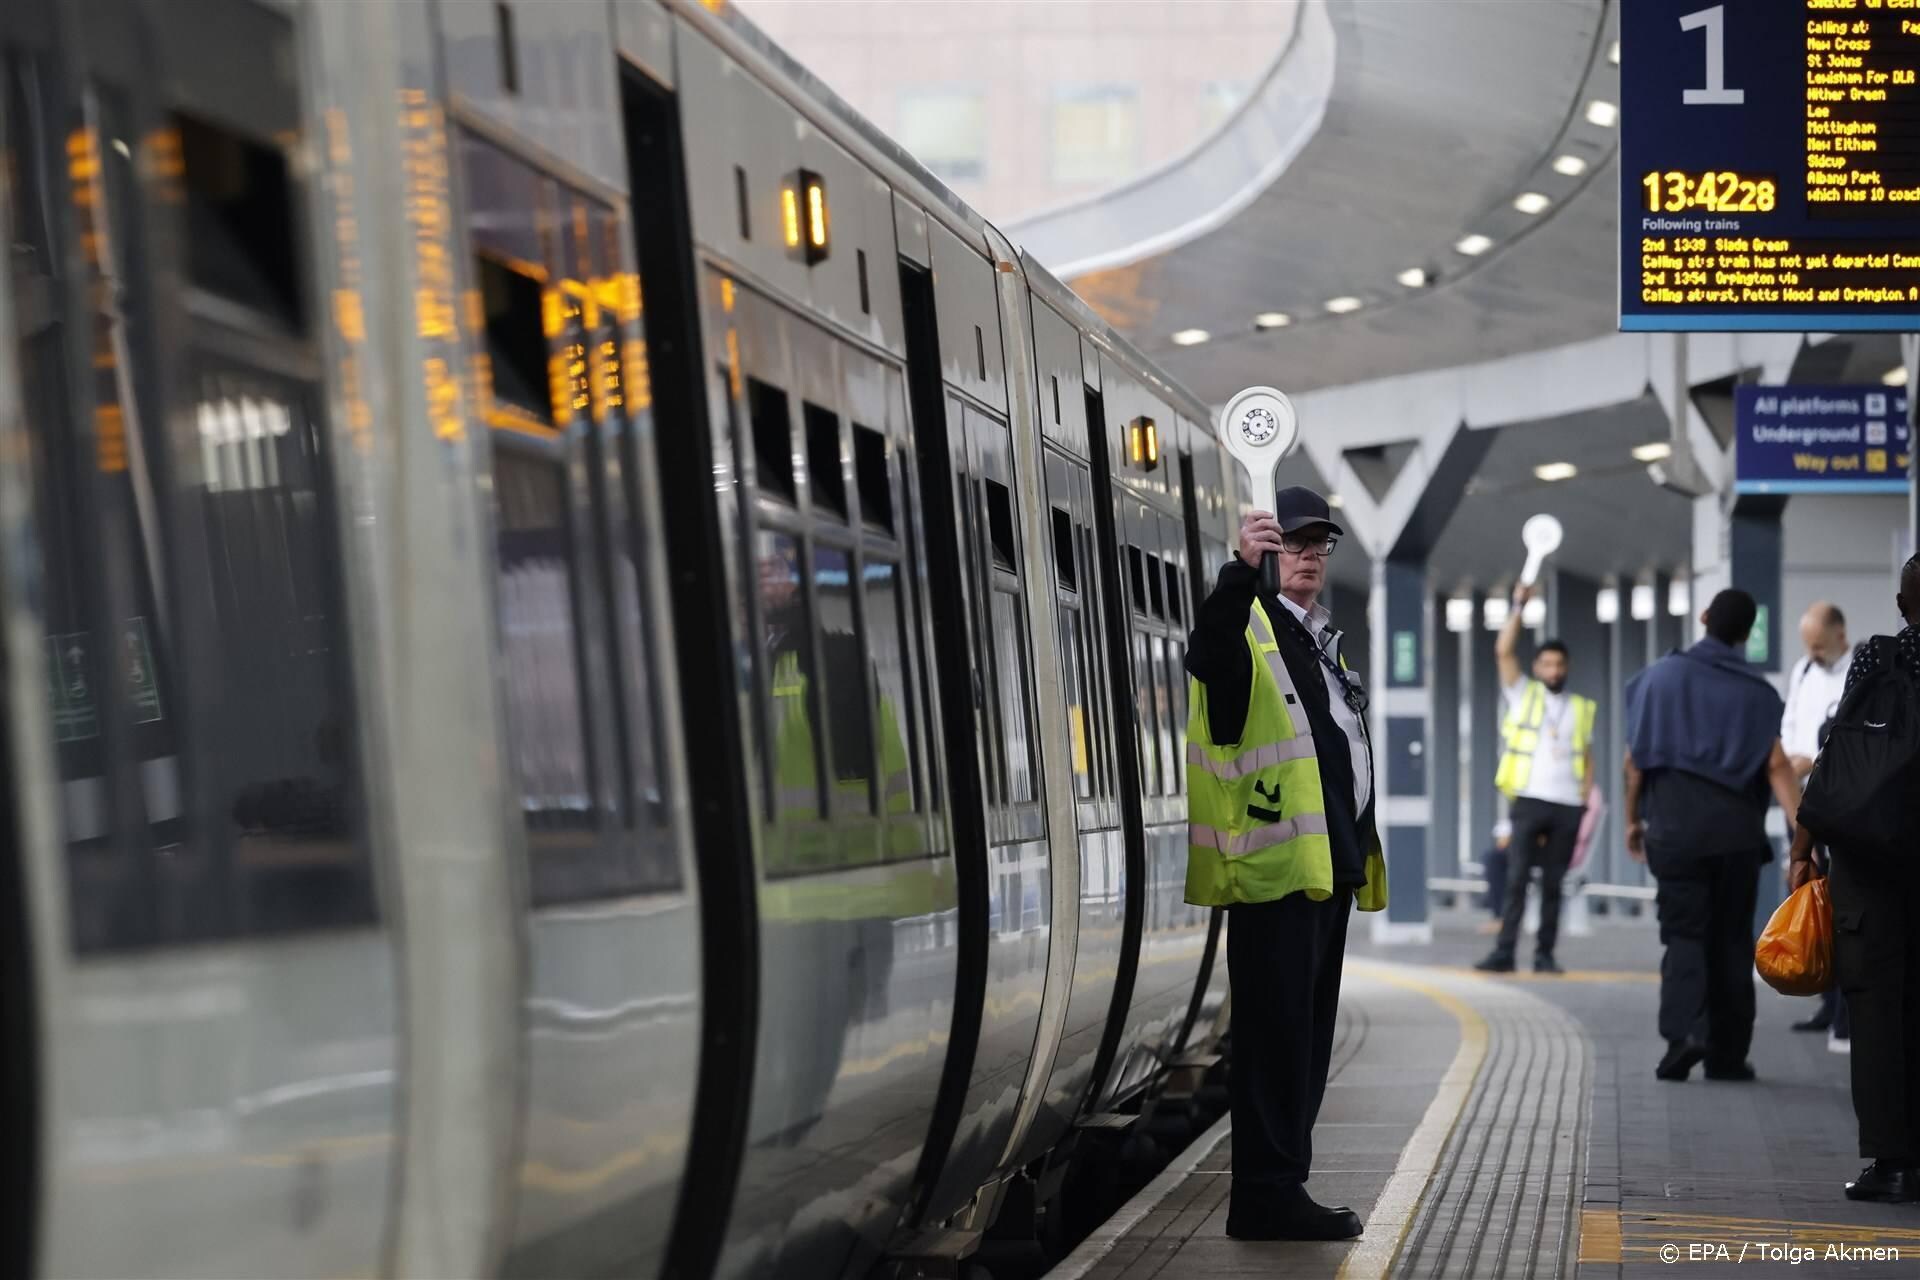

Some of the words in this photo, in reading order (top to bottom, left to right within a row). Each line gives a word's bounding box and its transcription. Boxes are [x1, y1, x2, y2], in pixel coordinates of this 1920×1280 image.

[1807, 20, 1848, 35] Calling
[1851, 20, 1870, 34] at:
[1807, 37, 1831, 51] New
[1834, 37, 1871, 51] Cross
[1679, 4, 1745, 105] 1
[1807, 53, 1823, 68] St
[1826, 53, 1863, 68] Johns
[1807, 70, 1863, 84] Lewisham
[1866, 70, 1889, 84] For
[1892, 70, 1915, 84] DLR
[1807, 87, 1846, 101] Hither
[1850, 87, 1886, 101] Green
[1807, 103, 1830, 118] Lee
[1807, 120, 1877, 136] Mottingham
[1807, 137, 1831, 151] New
[1834, 137, 1877, 151] Eltham
[1807, 153, 1847, 169] Sidcup
[1807, 170, 1848, 186] Albany
[1851, 170, 1881, 184] Park
[1807, 187, 1841, 201] which
[1844, 187, 1867, 201] has
[1870, 187, 1885, 201] 10
[1642, 218, 1702, 233] Following
[1705, 218, 1740, 231] trains
[1642, 238, 1665, 252] 2nd
[1673, 238, 1707, 252] 13:39
[1715, 238, 1749, 252] Slade
[1752, 238, 1789, 252] Green
[1642, 254, 1683, 270] Calling
[1719, 254, 1750, 268] train
[1754, 254, 1777, 268] has
[1780, 254, 1802, 268] not
[1806, 254, 1829, 270] yet
[1832, 254, 1889, 269] departed
[1892, 253, 1920, 268] Cann
[1642, 271, 1665, 285] 3rd
[1673, 271, 1707, 285] 13:54
[1715, 271, 1775, 286] Orpington
[1778, 271, 1799, 285] via
[1642, 288, 1683, 303] Calling
[1742, 288, 1779, 301] Petts
[1783, 288, 1814, 301] Wood
[1817, 288, 1840, 301] and
[1843, 287, 1905, 303] Orpington.
[1909, 287, 1918, 301] A
[1754, 396, 1778, 414] All
[1780, 396, 1860, 417] platforms
[1752, 424, 1860, 446] Underground
[1793, 453, 1828, 473] Way
[1831, 453, 1859, 470] out
